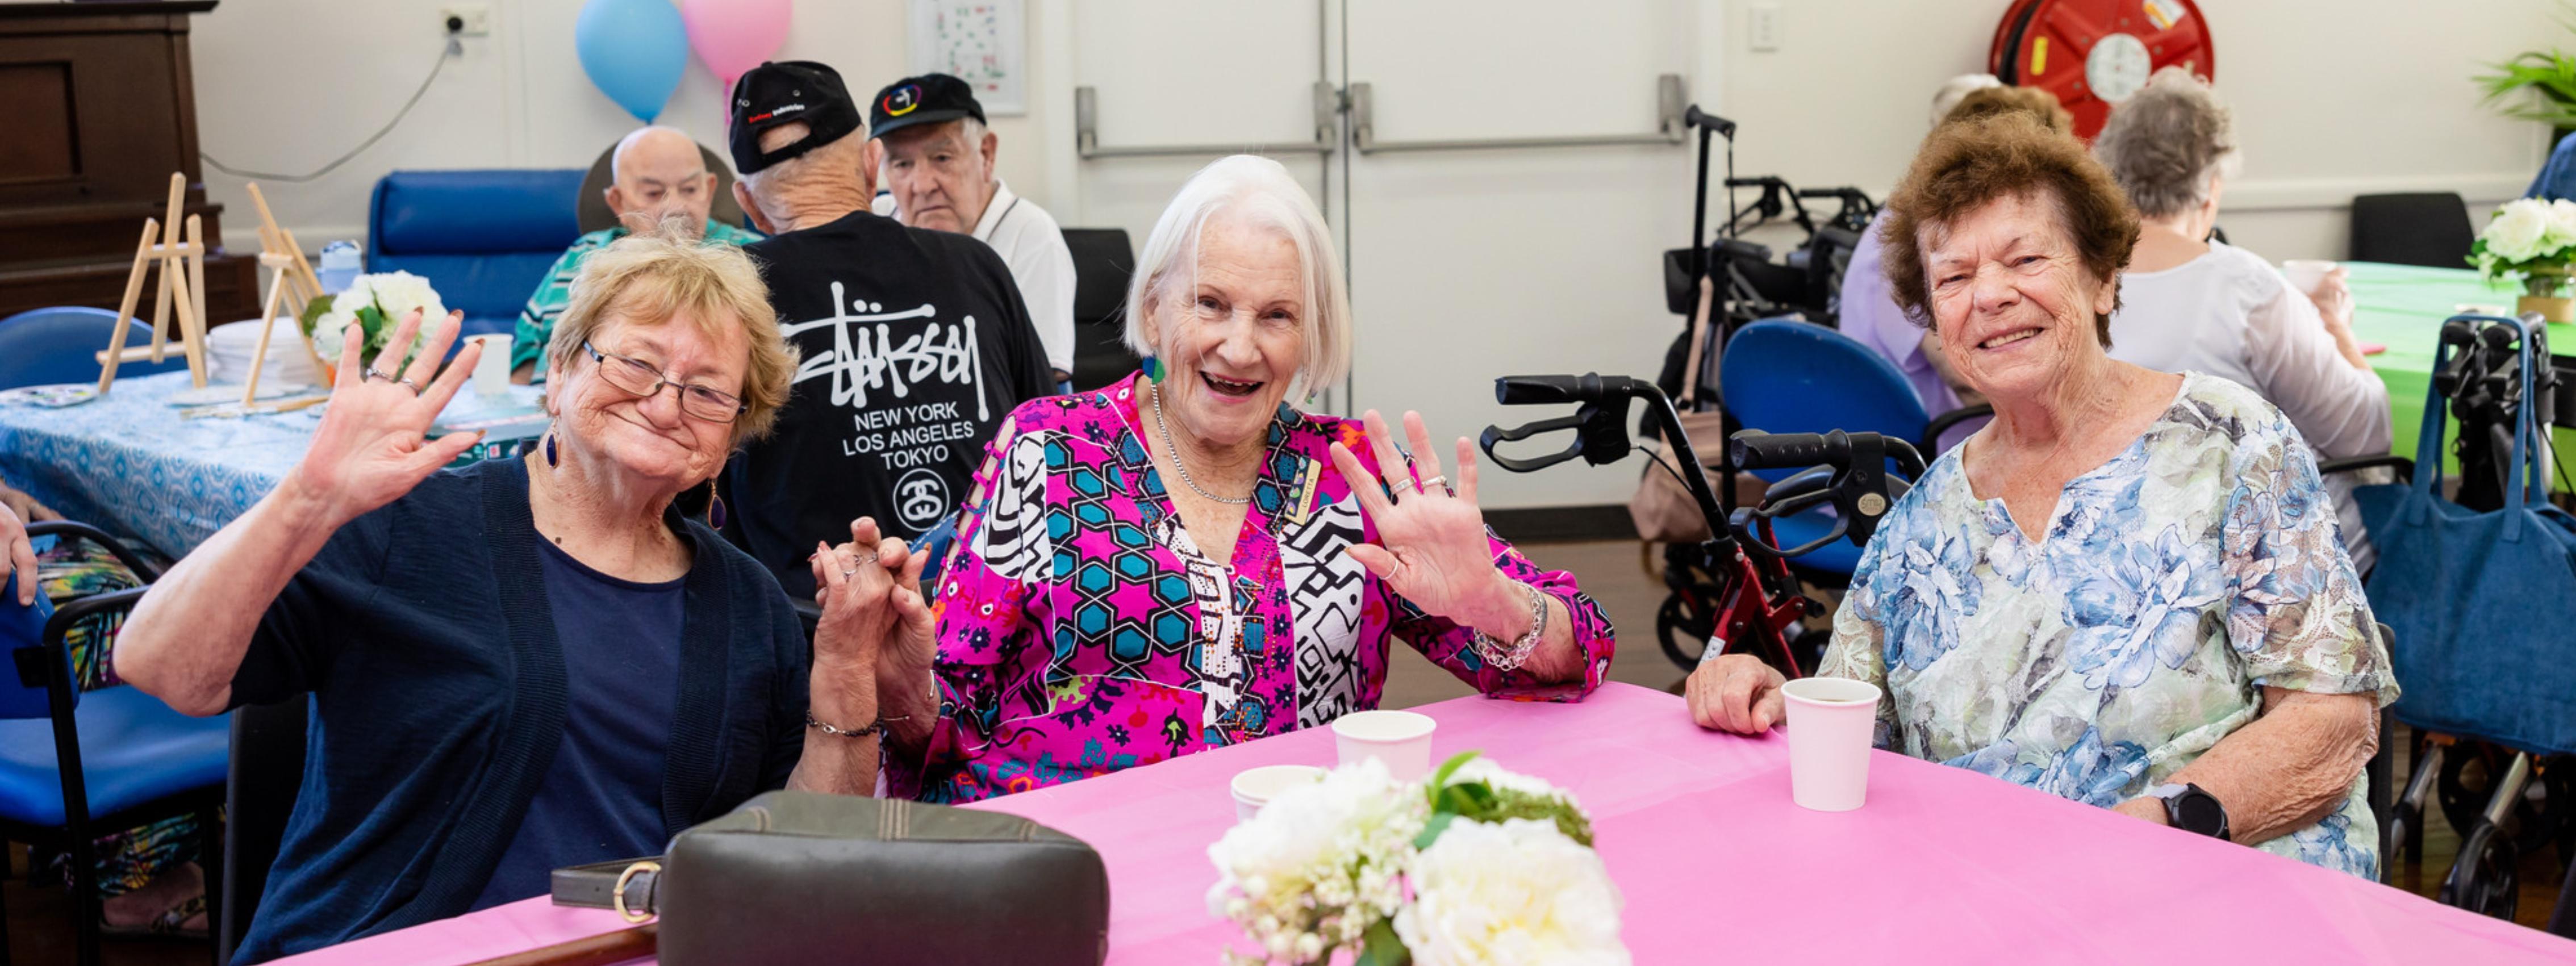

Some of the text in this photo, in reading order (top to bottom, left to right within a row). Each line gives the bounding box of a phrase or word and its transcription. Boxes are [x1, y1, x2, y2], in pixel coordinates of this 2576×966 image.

[854, 401, 959, 432] NEW YORK
[842, 421, 974, 456] LOS ANGELES
[880, 445, 949, 470] TOKYO
[1302, 478, 1314, 508] LORETTA
